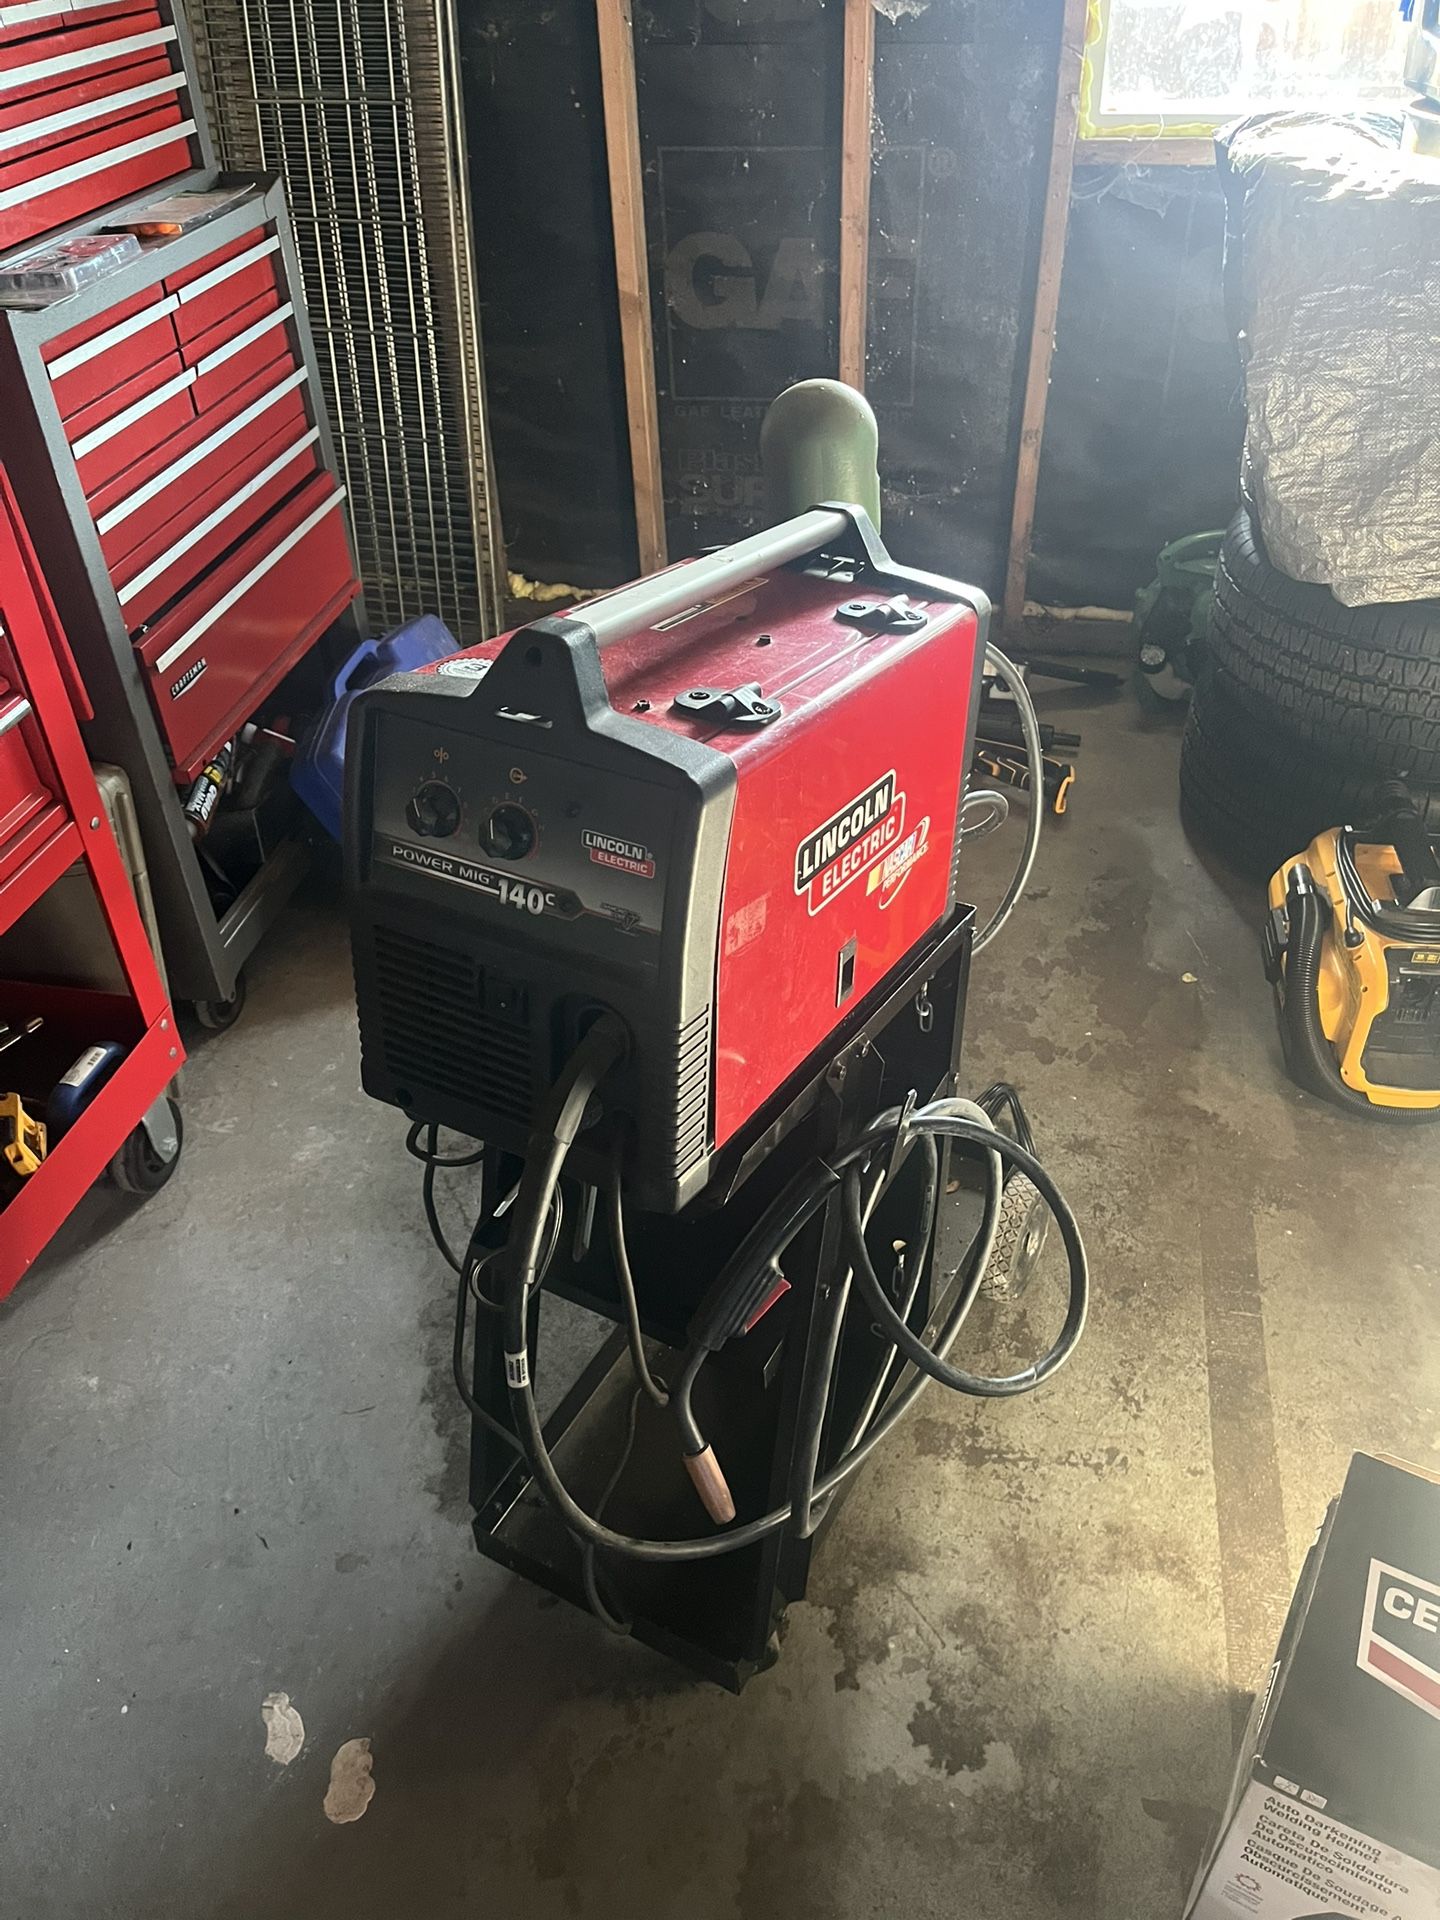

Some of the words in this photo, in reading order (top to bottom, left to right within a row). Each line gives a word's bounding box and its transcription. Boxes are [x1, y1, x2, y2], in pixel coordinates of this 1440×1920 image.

[585, 832, 643, 860] LINCOLN
[597, 850, 648, 874] ELECTRIC
[801, 783, 890, 880] LINCOLN
[821, 815, 896, 898] ELECTRIC
[392, 845, 453, 873] POWER
[459, 865, 491, 886] MIG
[1255, 1821, 1274, 1836] De
[1278, 1831, 1393, 1895] Oscurecimiento
[1258, 1814, 1306, 1842] Careta
[1310, 1839, 1330, 1853] De
[1332, 1851, 1410, 1894] Soldadura
[1263, 1802, 1322, 1837] Welding
[1325, 1834, 1380, 1865] Helmet
[1266, 1795, 1300, 1817] Auto
[1304, 1813, 1382, 1856] Darkening
[1240, 1852, 1329, 1904] Automatique
[1243, 1845, 1367, 1914] Obscurcissement
[1246, 1838, 1299, 1870] Casque
[1302, 1866, 1322, 1882] De
[1324, 1878, 1389, 1917] Soudage
